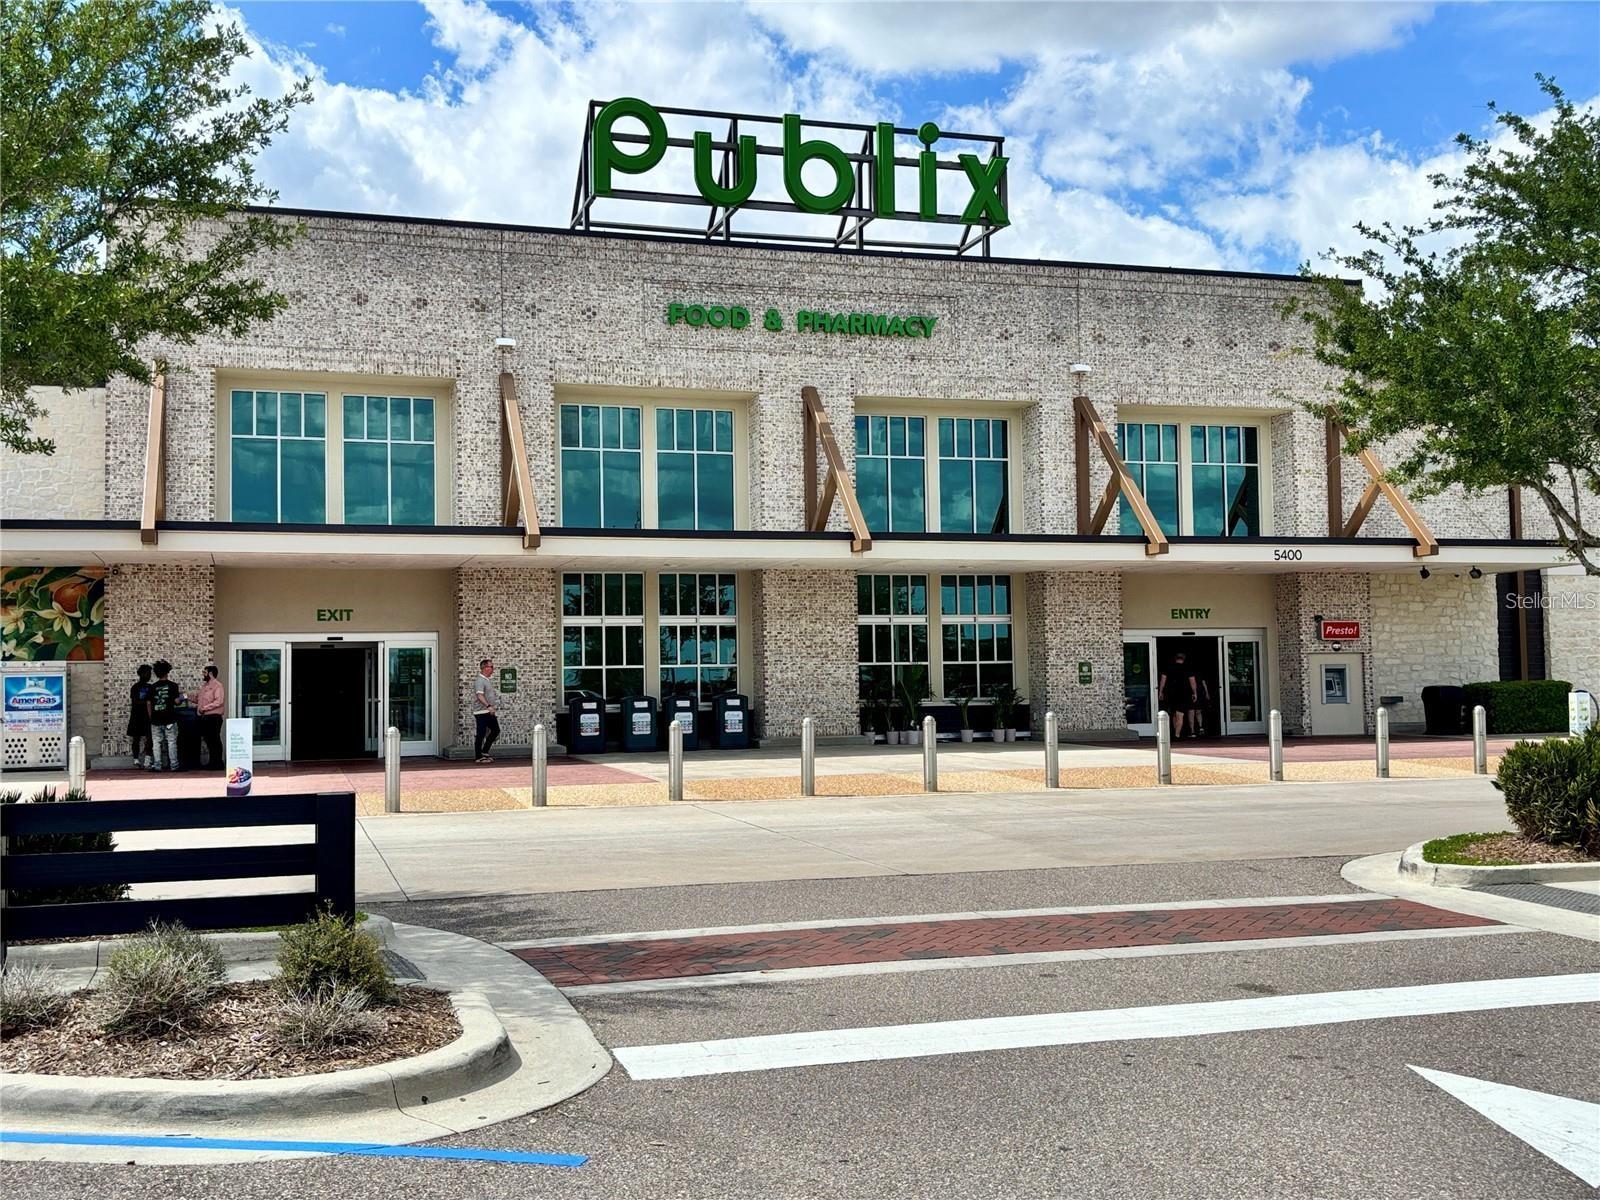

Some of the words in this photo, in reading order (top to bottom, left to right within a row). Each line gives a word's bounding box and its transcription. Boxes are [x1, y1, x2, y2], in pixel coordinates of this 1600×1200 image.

[592, 97, 1010, 226] Publix
[668, 303, 750, 329] FOOD
[763, 307, 783, 332] &
[797, 309, 939, 338] PHARMACY
[1274, 549, 1303, 561] 5400
[316, 608, 354, 622] EXIT
[1170, 608, 1211, 619] ENTRY
[1325, 626, 1358, 635] Presto!
